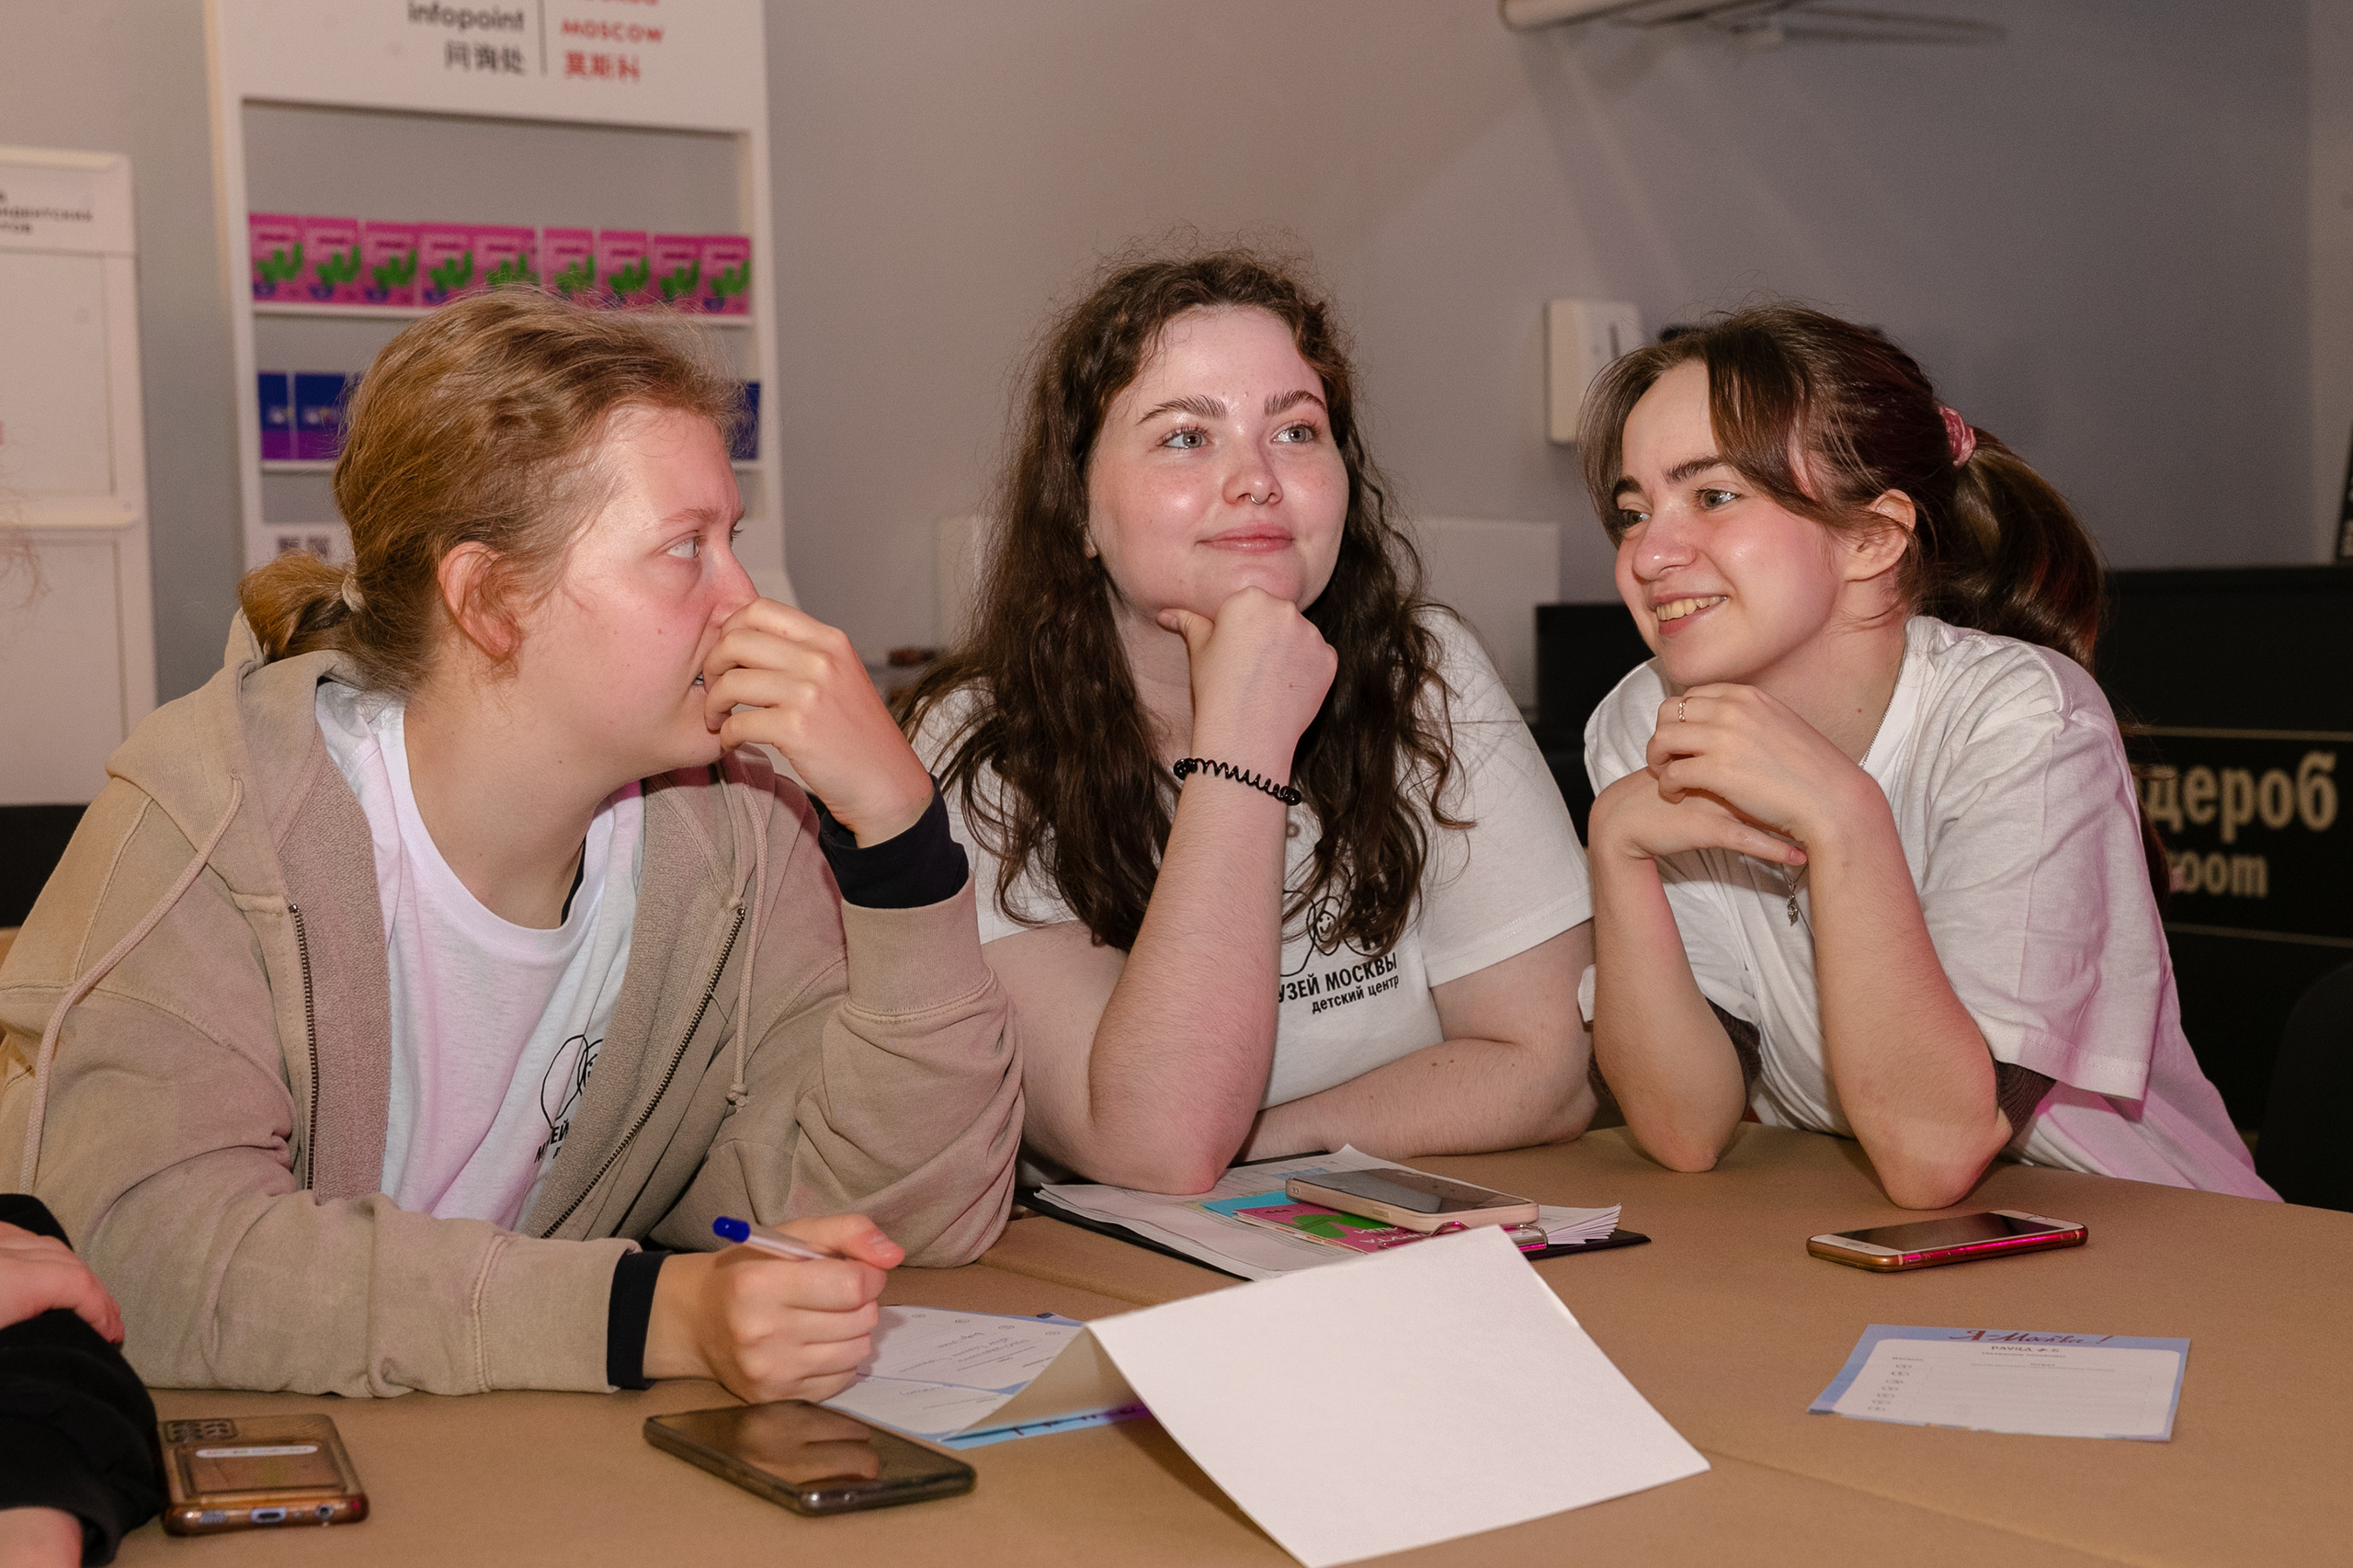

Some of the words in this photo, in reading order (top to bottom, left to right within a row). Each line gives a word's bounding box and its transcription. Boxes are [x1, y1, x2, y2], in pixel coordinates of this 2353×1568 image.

[407, 1, 525, 34] infopoint
[562, 19, 665, 42] MOSCOW
[2133, 750, 2338, 844] дероб
[1324, 952, 1398, 992] МОСКВЫ
[1312, 984, 1365, 1014] детский
[1368, 974, 1399, 997] центр
